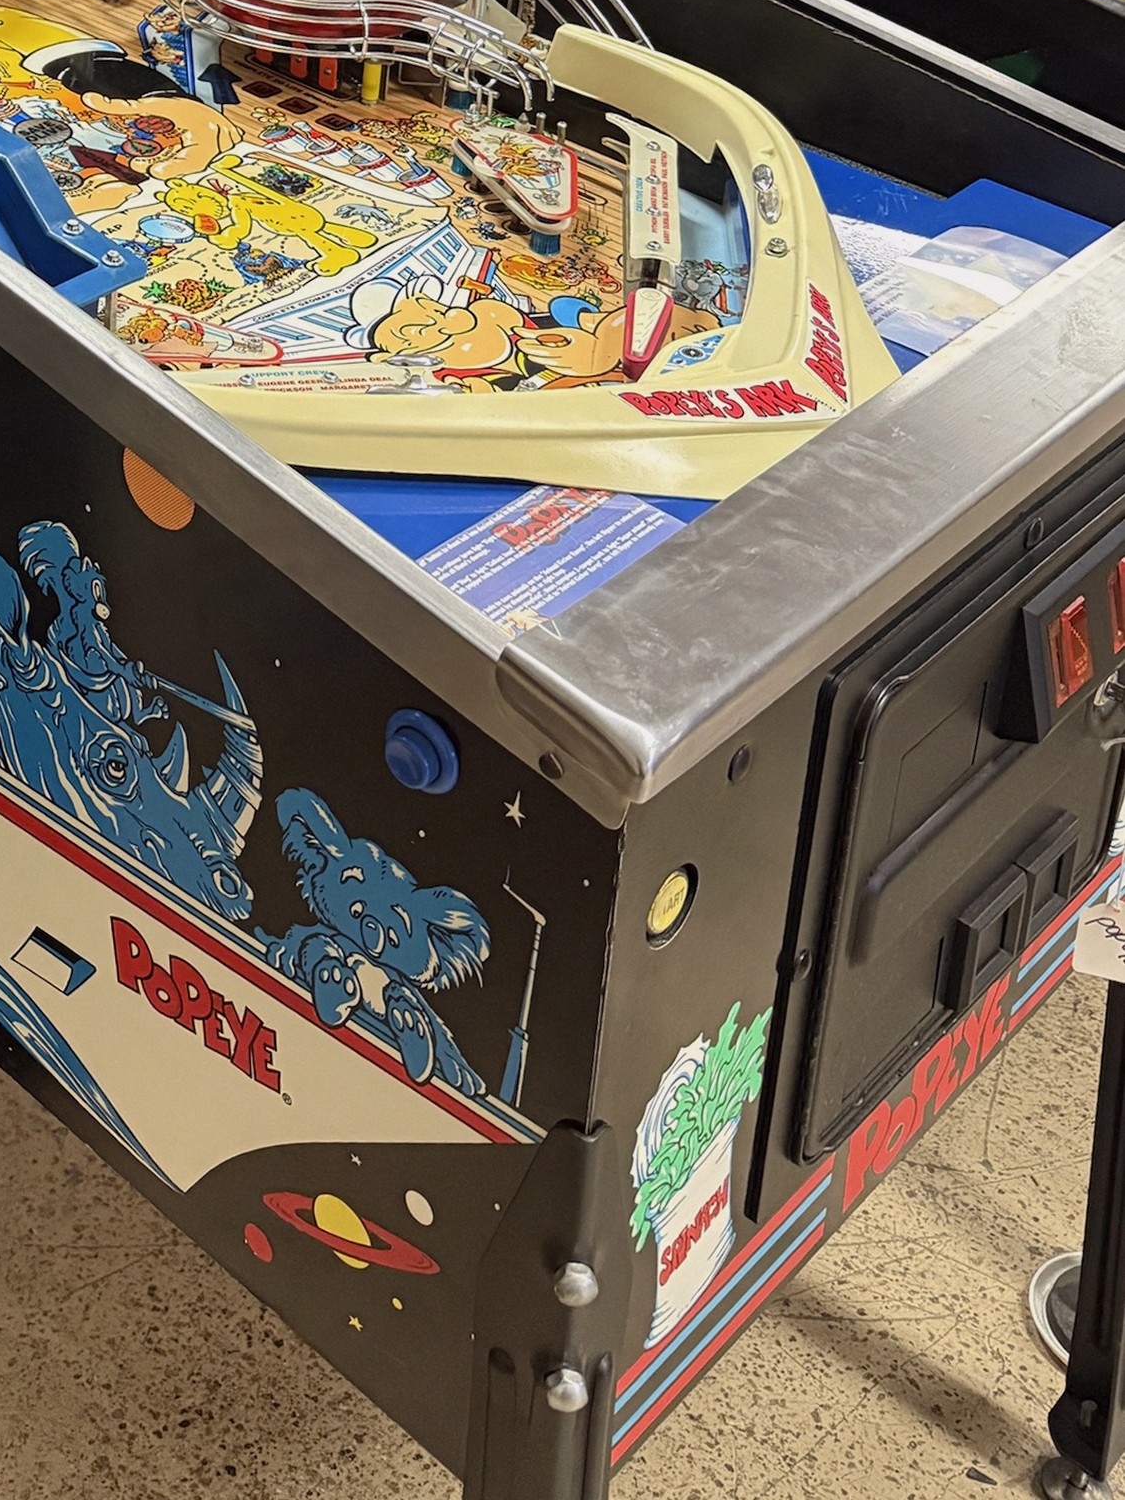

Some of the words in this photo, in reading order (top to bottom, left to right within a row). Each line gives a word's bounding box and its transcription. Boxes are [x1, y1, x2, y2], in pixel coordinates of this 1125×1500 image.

[17, 121, 54, 136] SAVE
[25, 124, 66, 143] OLIVE
[252, 305, 296, 323] COMPLETE
[334, 287, 345, 296] TO
[346, 275, 365, 293] BEGIN
[367, 255, 398, 275] STAMPEDE
[619, 389, 745, 419] POPEYE'S
[734, 380, 819, 418] ARK
[111, 916, 281, 1094] POPEYE
[842, 974, 1011, 1214] POPEYE
[658, 1179, 729, 1287] SPINACH
